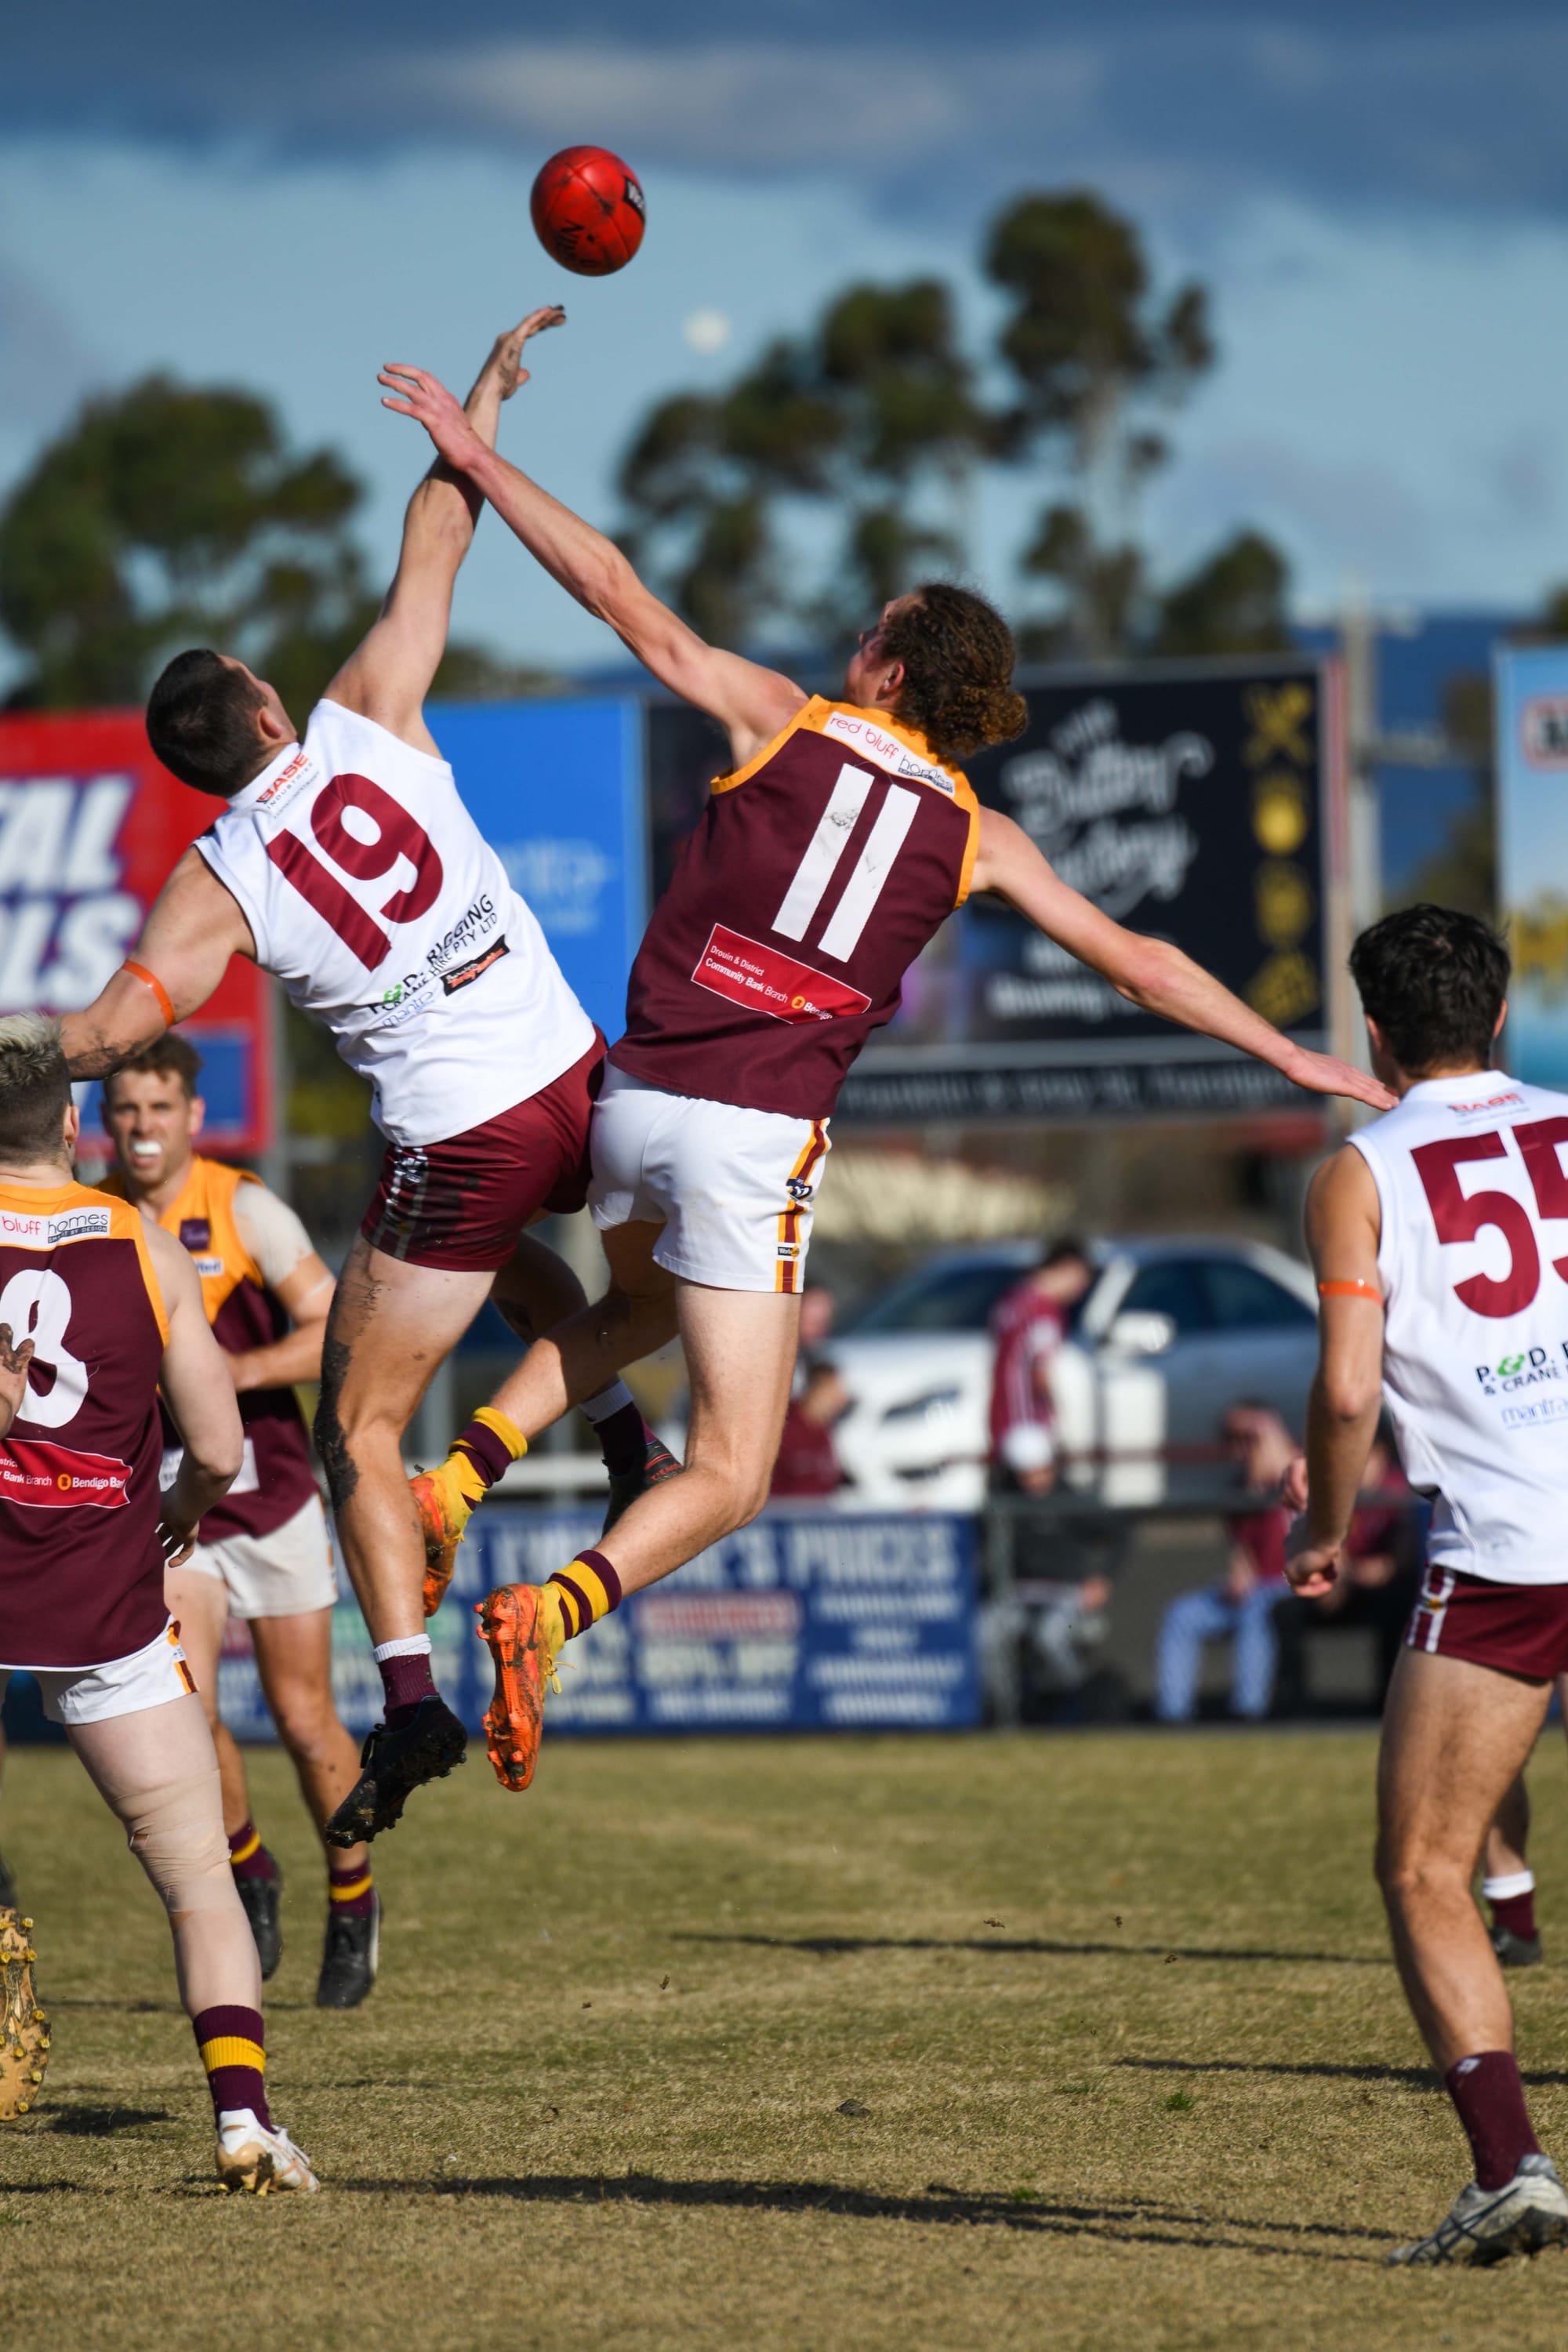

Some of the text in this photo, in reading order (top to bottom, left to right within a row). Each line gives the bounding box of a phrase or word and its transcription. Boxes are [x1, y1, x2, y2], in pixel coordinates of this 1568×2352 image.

[830, 717, 862, 735] red
[865, 728, 899, 759] bluff
[256, 752, 309, 802] BASE
[0, 775, 135, 890] AL
[266, 773, 444, 972] 19
[771, 763, 921, 964] 11
[426, 893, 494, 965] RIGGING
[428, 949, 452, 978] HIRE
[452, 929, 477, 953] PTY
[479, 912, 499, 935] LTD
[705, 957, 746, 985] Community
[746, 976, 766, 993] Bank
[764, 985, 789, 1004] Branch
[710, 945, 765, 977] Drouin & District
[2, 1214, 108, 1236] bluff homes
[0, 1269, 89, 1428] 8
[1476, 1366, 1496, 1383] P.
[3, 1470, 25, 1484] Bank
[26, 1474, 53, 1486] Branch
[72, 1477, 109, 1490] Bendigo
